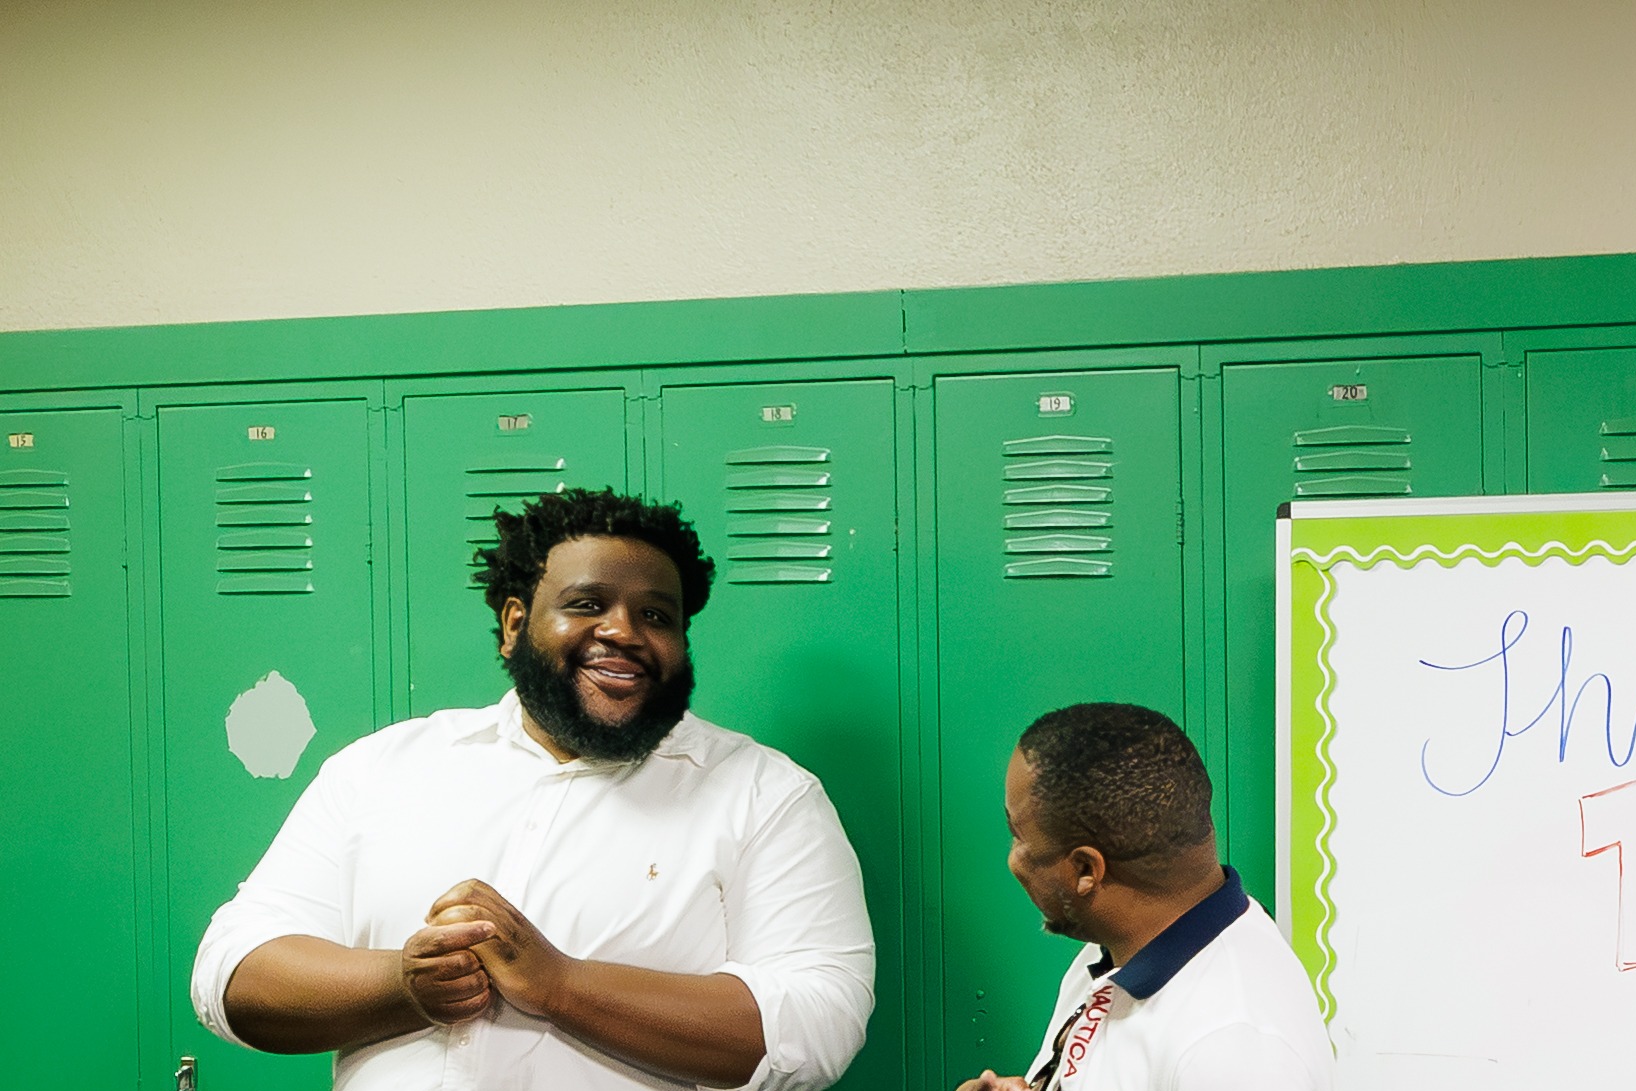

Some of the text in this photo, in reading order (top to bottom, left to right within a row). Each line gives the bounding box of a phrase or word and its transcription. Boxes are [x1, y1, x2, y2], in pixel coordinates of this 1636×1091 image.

[1342, 386, 1358, 400] 20
[1049, 399, 1060, 411] 19
[771, 409, 781, 421] 18
[507, 417, 518, 429] 17
[256, 427, 266, 439] 16
[16, 435, 26, 447] 15
[1063, 985, 1114, 1078] NAUTICA
